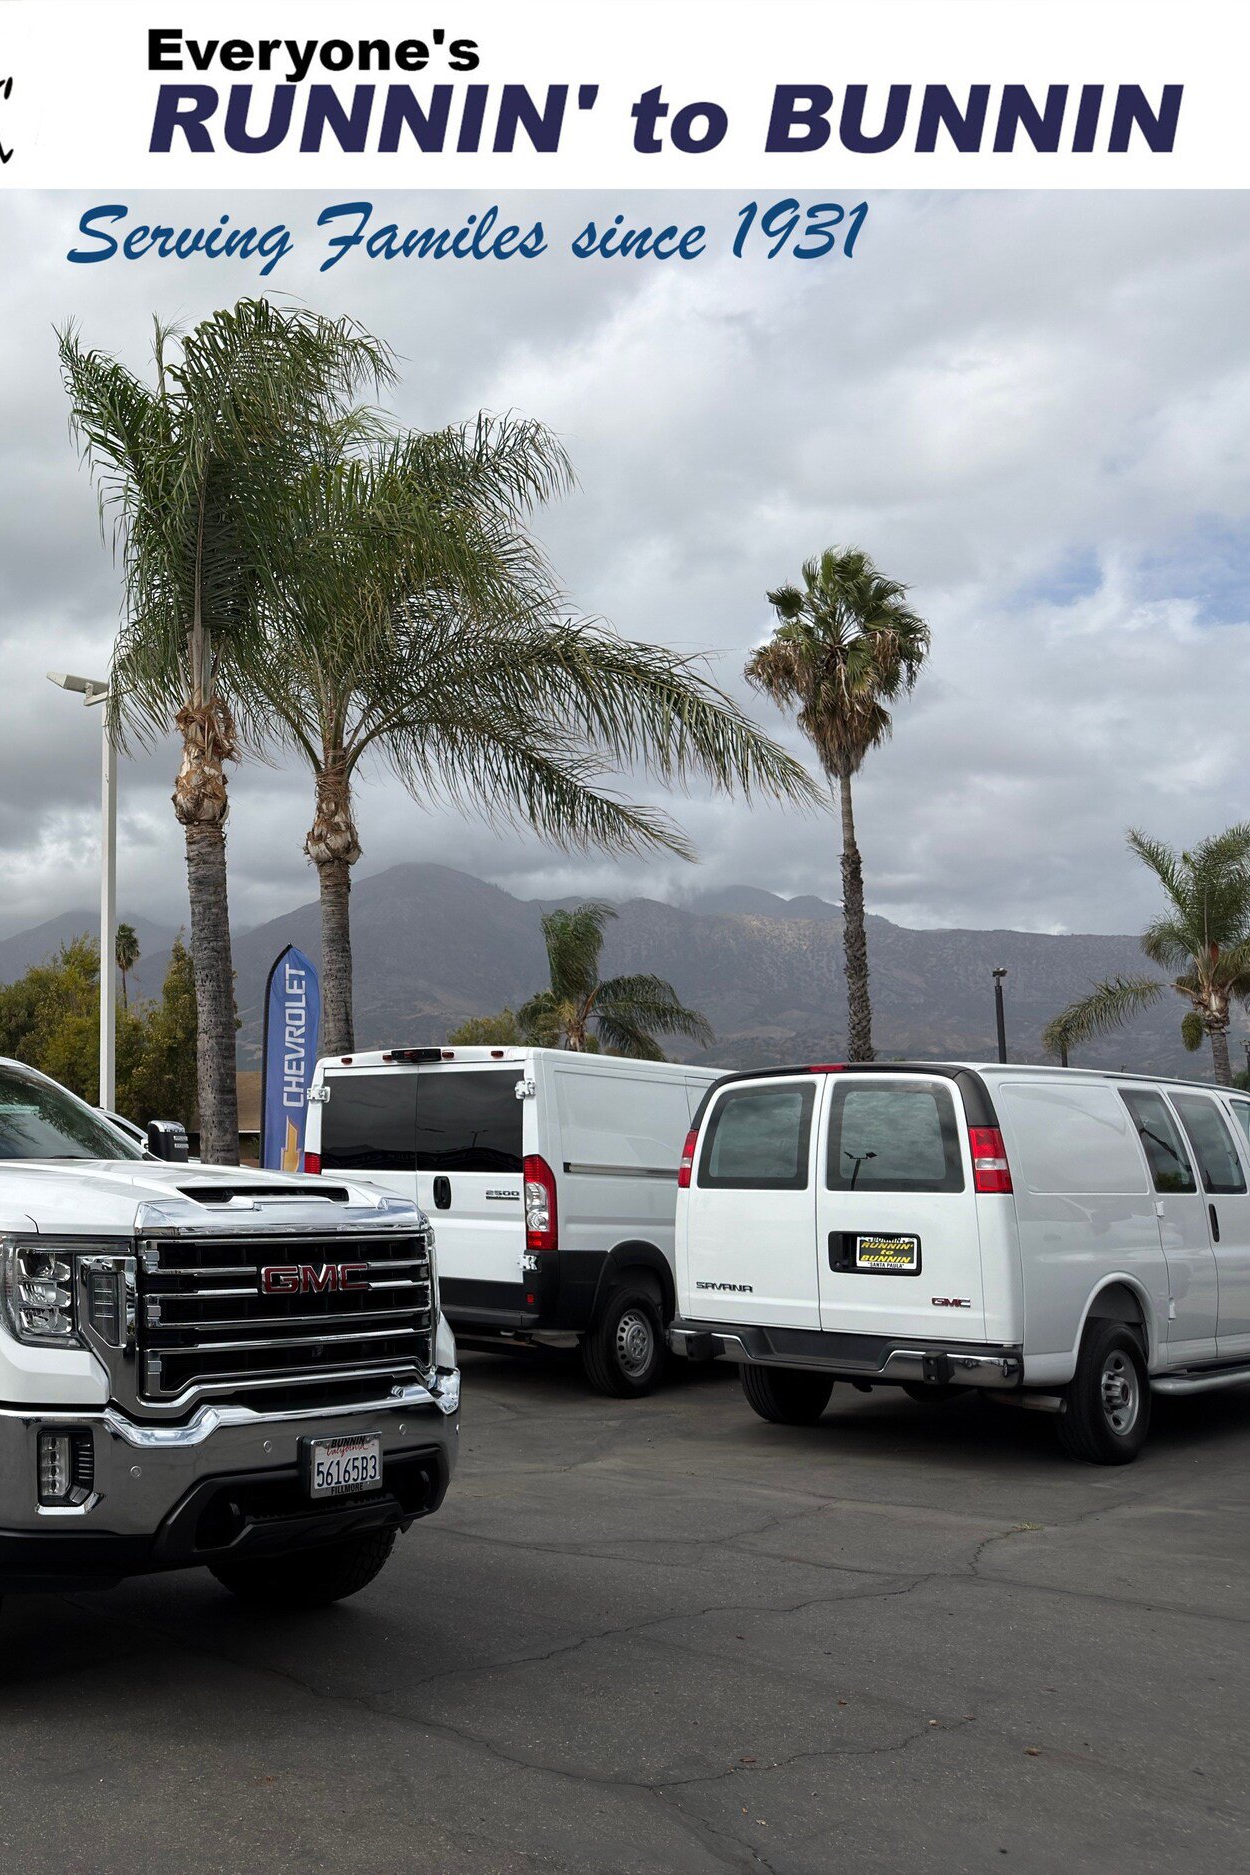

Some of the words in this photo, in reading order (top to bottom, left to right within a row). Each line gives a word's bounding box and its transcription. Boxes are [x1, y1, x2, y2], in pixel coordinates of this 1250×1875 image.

[282, 963, 307, 1109] CHEVROLET
[860, 1241, 914, 1250] RUNNIN'
[860, 1255, 911, 1263] BUNNIN
[261, 1263, 369, 1295] GMC
[696, 1281, 753, 1293] SAVANA
[931, 1296, 971, 1308] GMC
[330, 1436, 367, 1448] BUNNIN
[316, 1454, 378, 1488] 56165B3
[331, 1482, 364, 1495] FILLMORE
